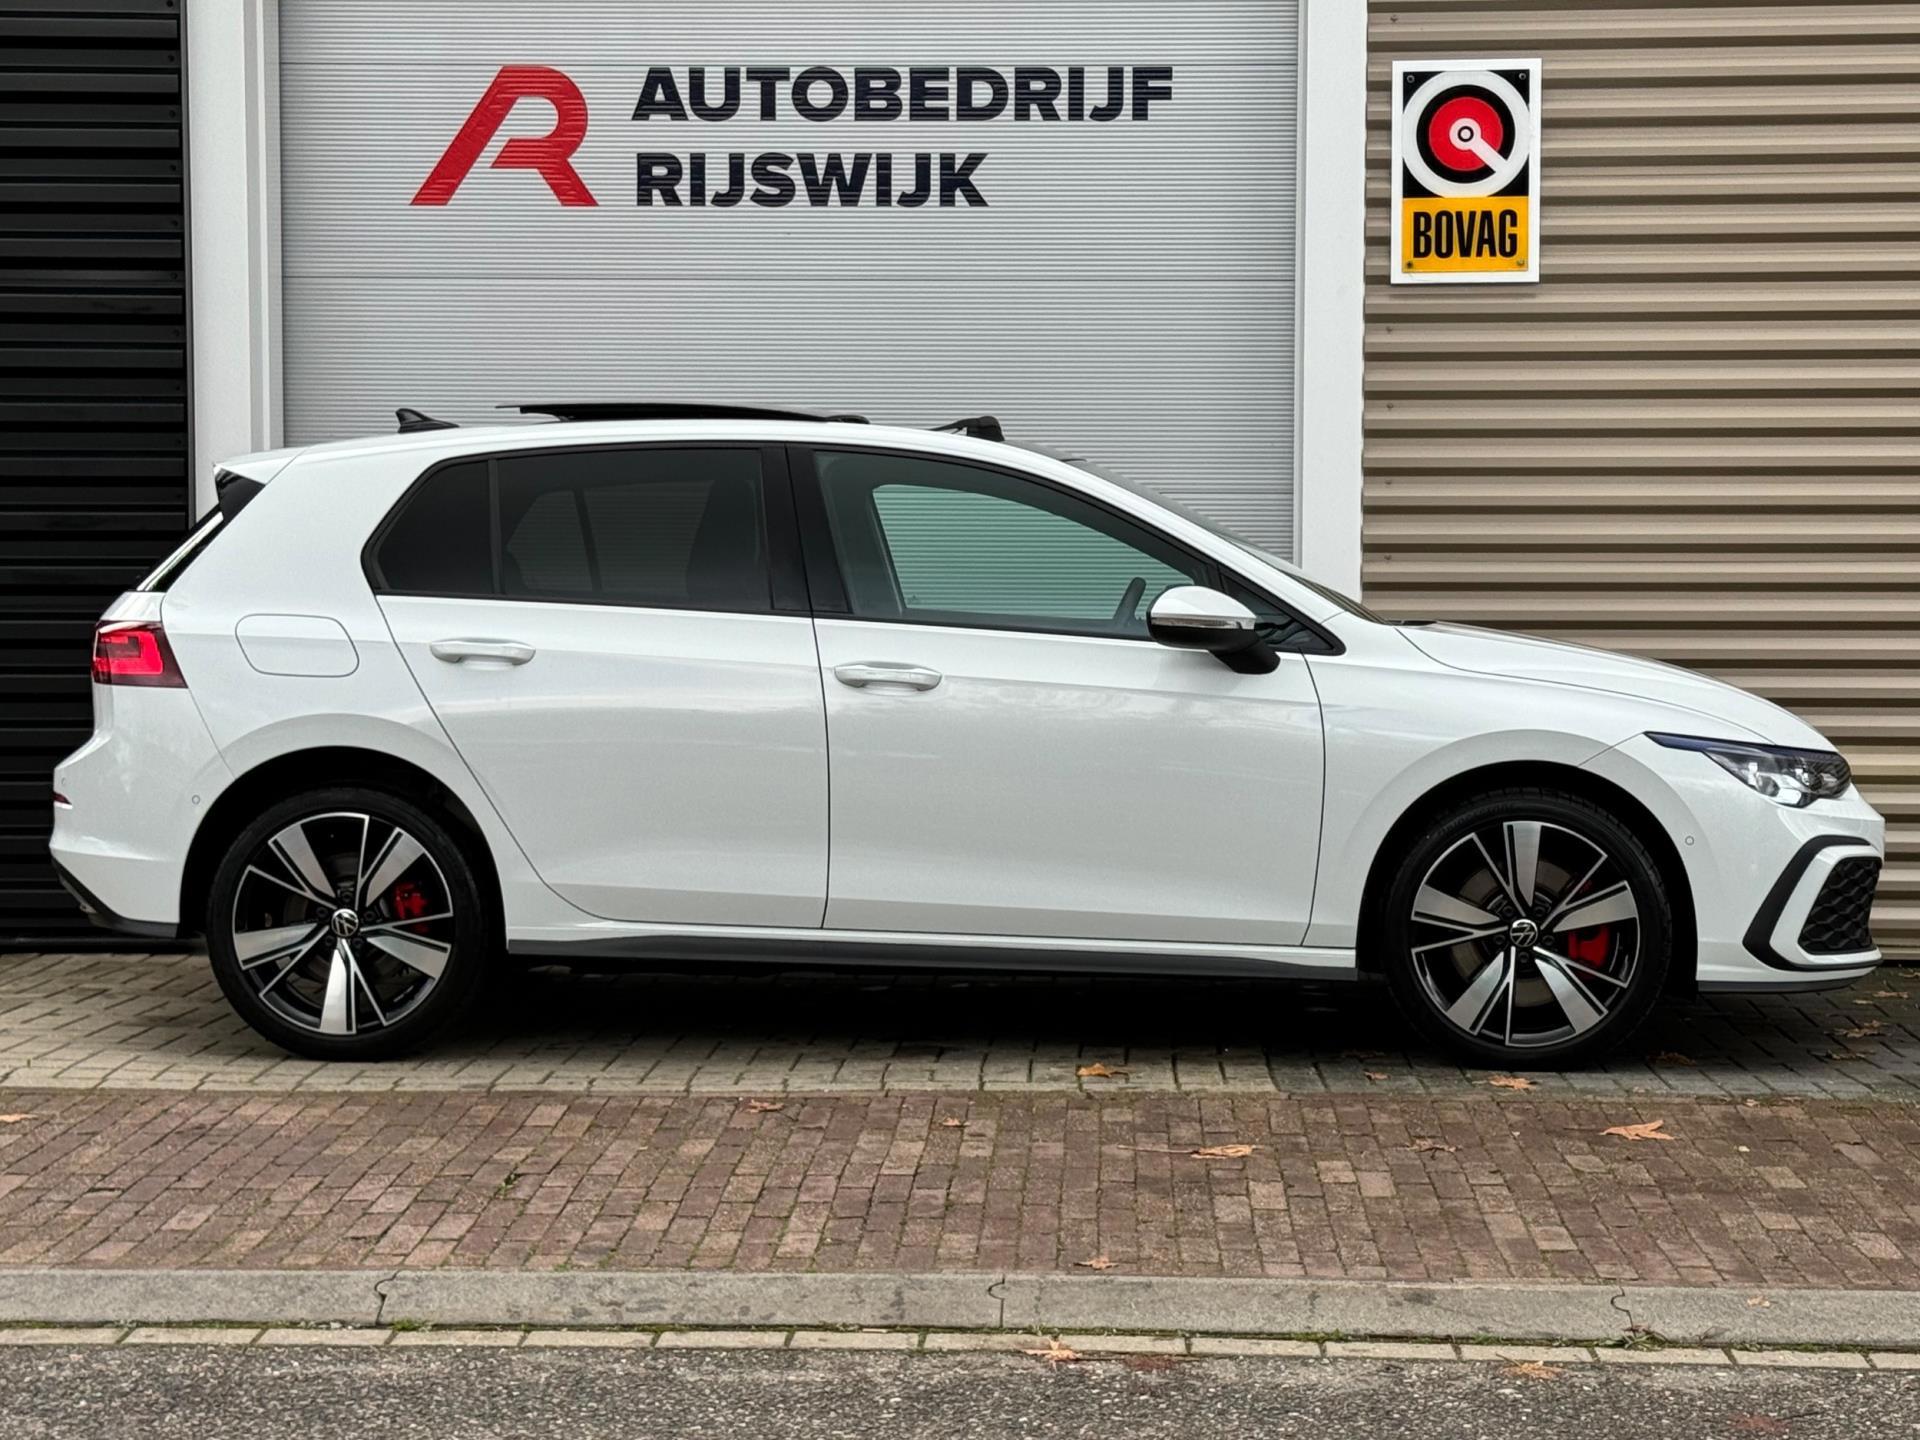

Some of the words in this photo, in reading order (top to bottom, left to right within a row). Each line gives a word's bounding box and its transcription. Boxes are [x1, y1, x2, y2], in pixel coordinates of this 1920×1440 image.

[632, 66, 1173, 122] AUTOBEDRIJF
[636, 152, 988, 208] RIJSWIJK
[1413, 209, 1518, 259] BOVAG
